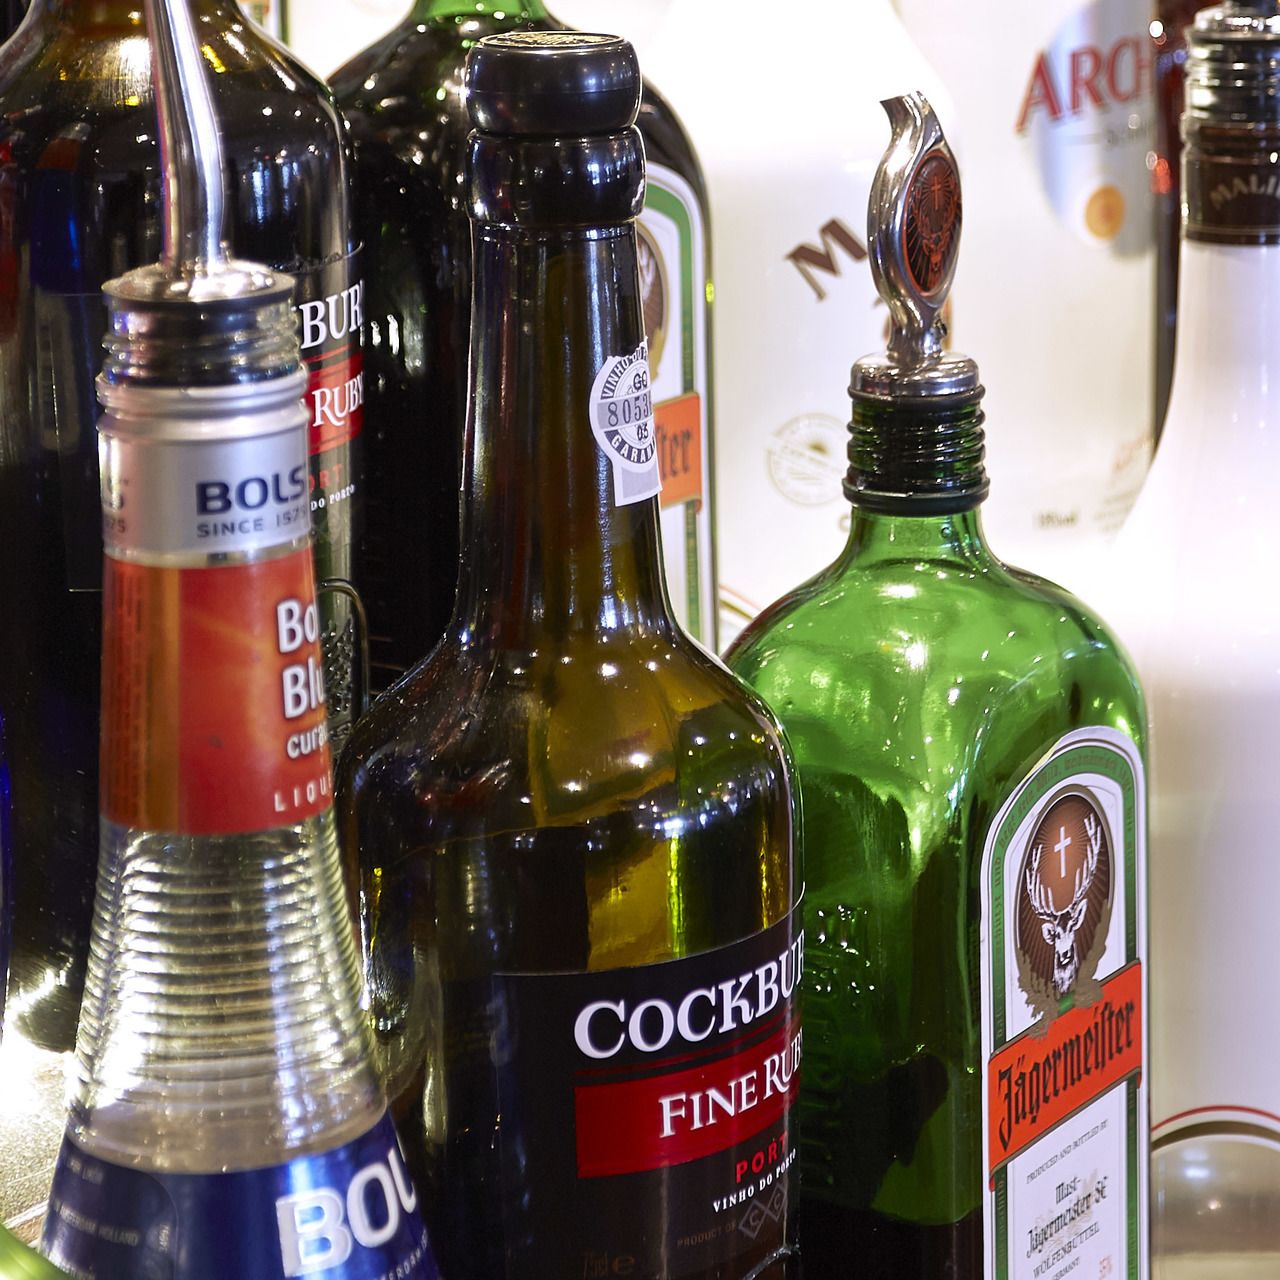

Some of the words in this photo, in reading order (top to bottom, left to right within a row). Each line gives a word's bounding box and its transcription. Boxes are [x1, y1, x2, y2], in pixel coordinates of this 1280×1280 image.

[313, 372, 363, 428] RUBY
[607, 393, 652, 428] 8053
[196, 466, 306, 516] BOLS
[311, 498, 325, 511] DO
[329, 484, 356, 505] PORTO
[197, 519, 264, 539] SINCE
[658, 1071, 758, 1138] FINE
[713, 1185, 755, 1213] VINHO
[759, 1173, 773, 1191] DO
[776, 1148, 796, 1178] PORTO
[736, 1130, 788, 1183] PORT
